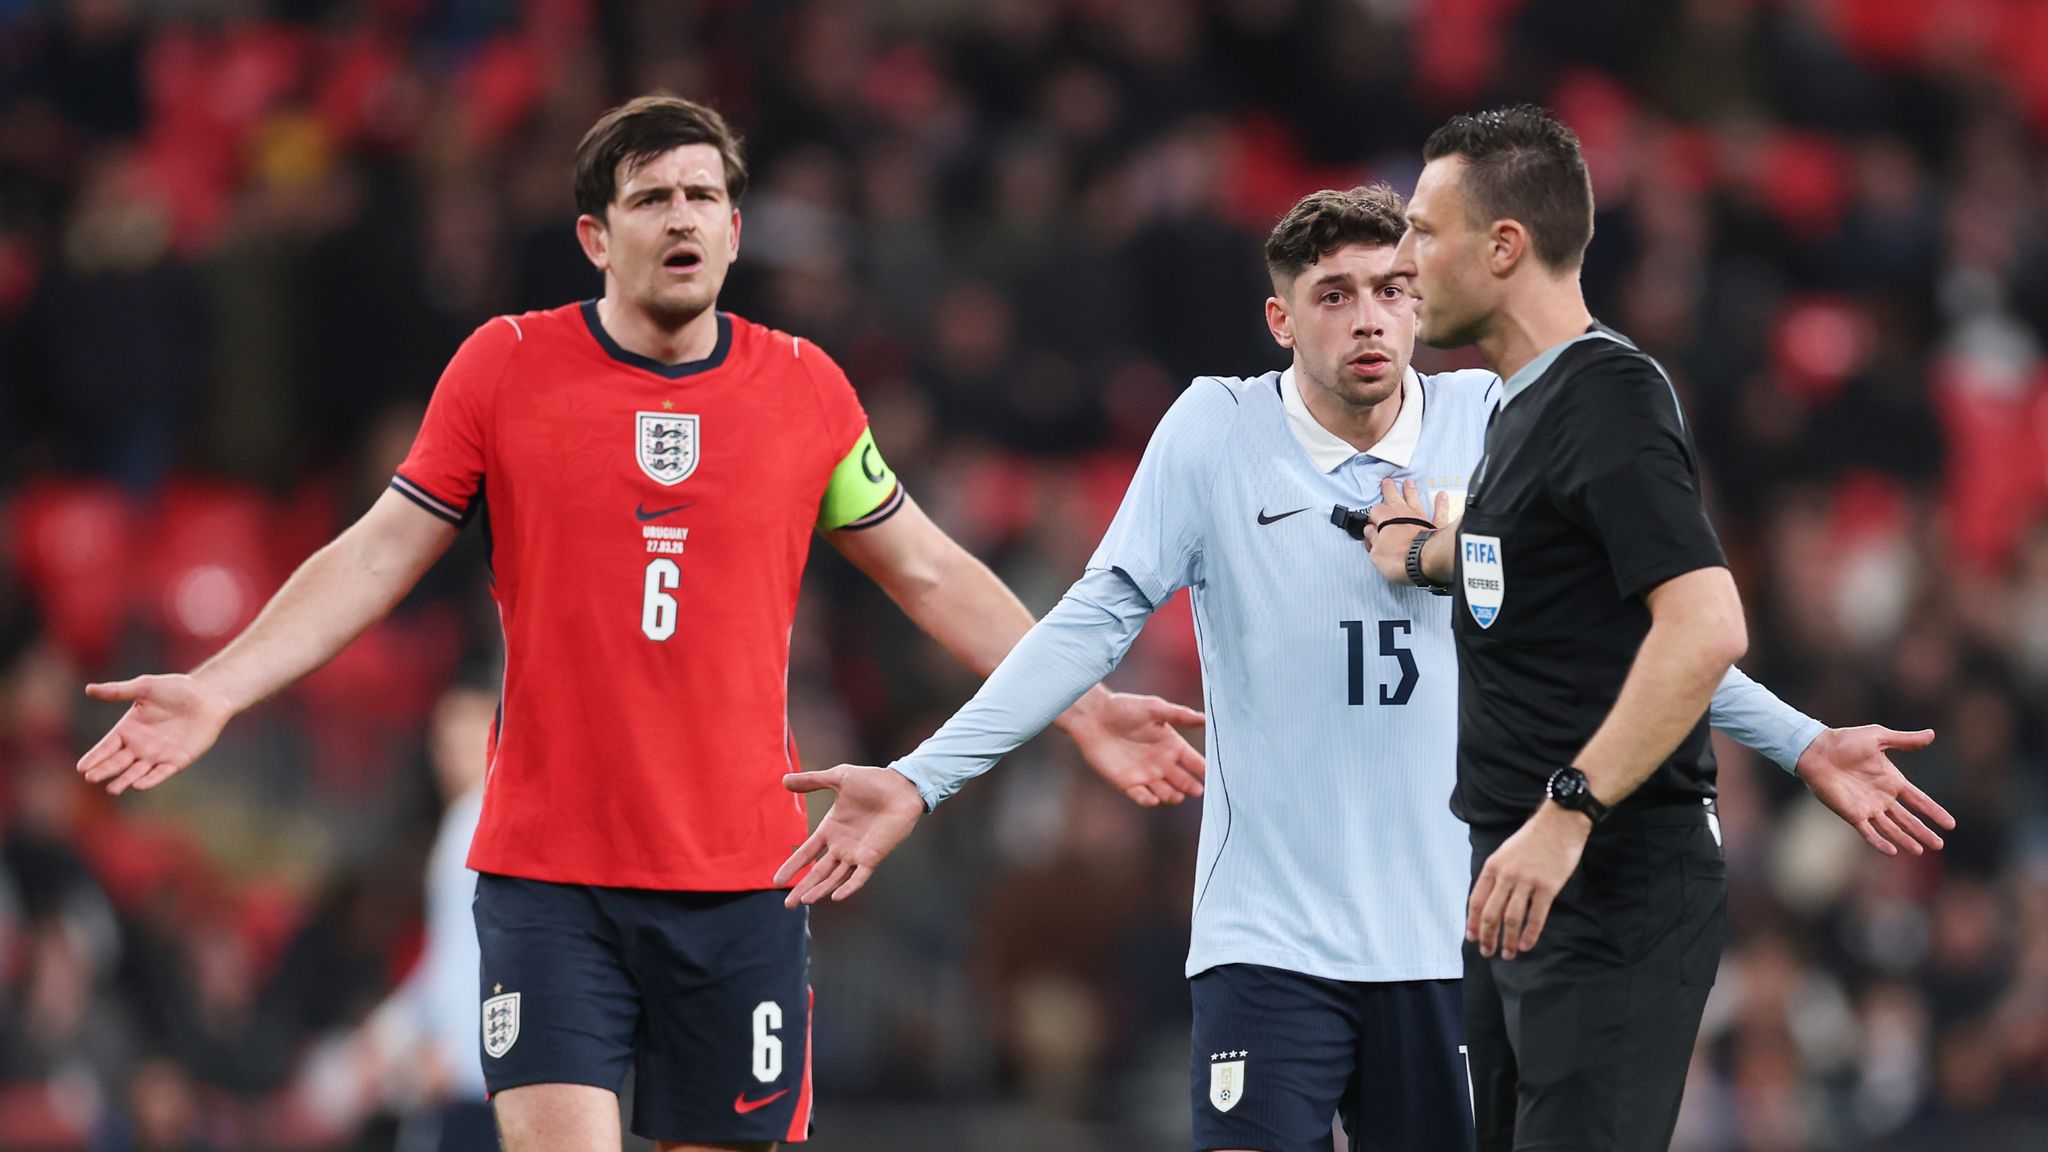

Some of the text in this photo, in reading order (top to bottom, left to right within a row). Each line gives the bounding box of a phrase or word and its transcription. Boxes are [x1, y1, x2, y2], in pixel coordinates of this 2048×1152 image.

[861, 442, 885, 484] C
[642, 525, 689, 541] URUGUAY
[646, 539, 684, 554] 27.03.26
[1466, 542, 1498, 565] FIFA
[640, 556, 682, 642] 6
[1467, 577, 1500, 591] REFEREE
[1339, 619, 1420, 706] 15
[752, 1000, 783, 1083] 6
